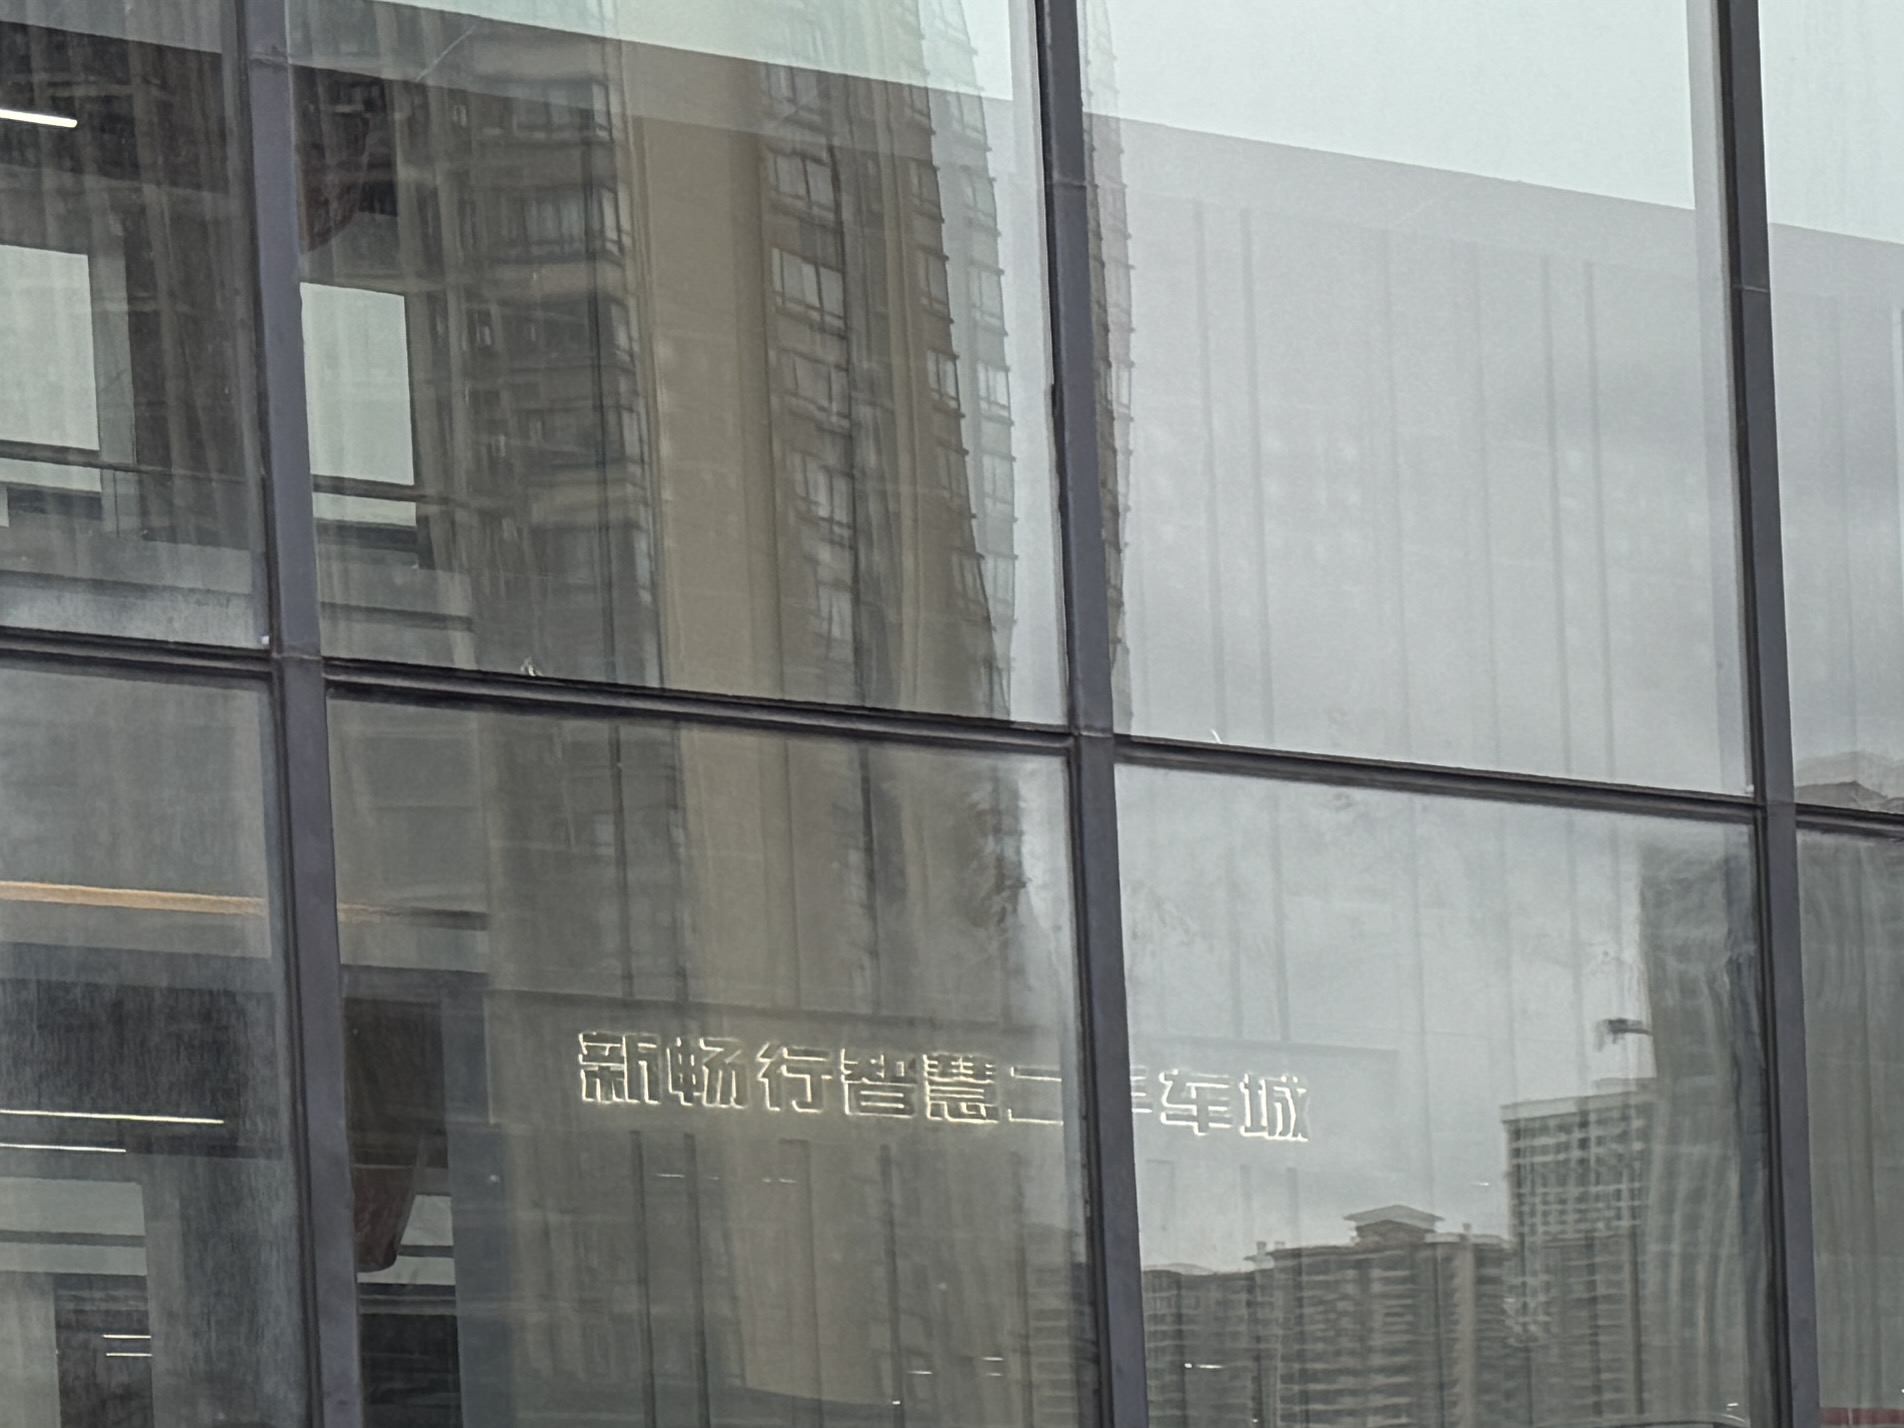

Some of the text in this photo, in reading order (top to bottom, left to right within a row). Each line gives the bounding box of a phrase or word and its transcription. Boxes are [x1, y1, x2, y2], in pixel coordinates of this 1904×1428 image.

[577, 1030, 1311, 1142] 新畅行智慧二车城
